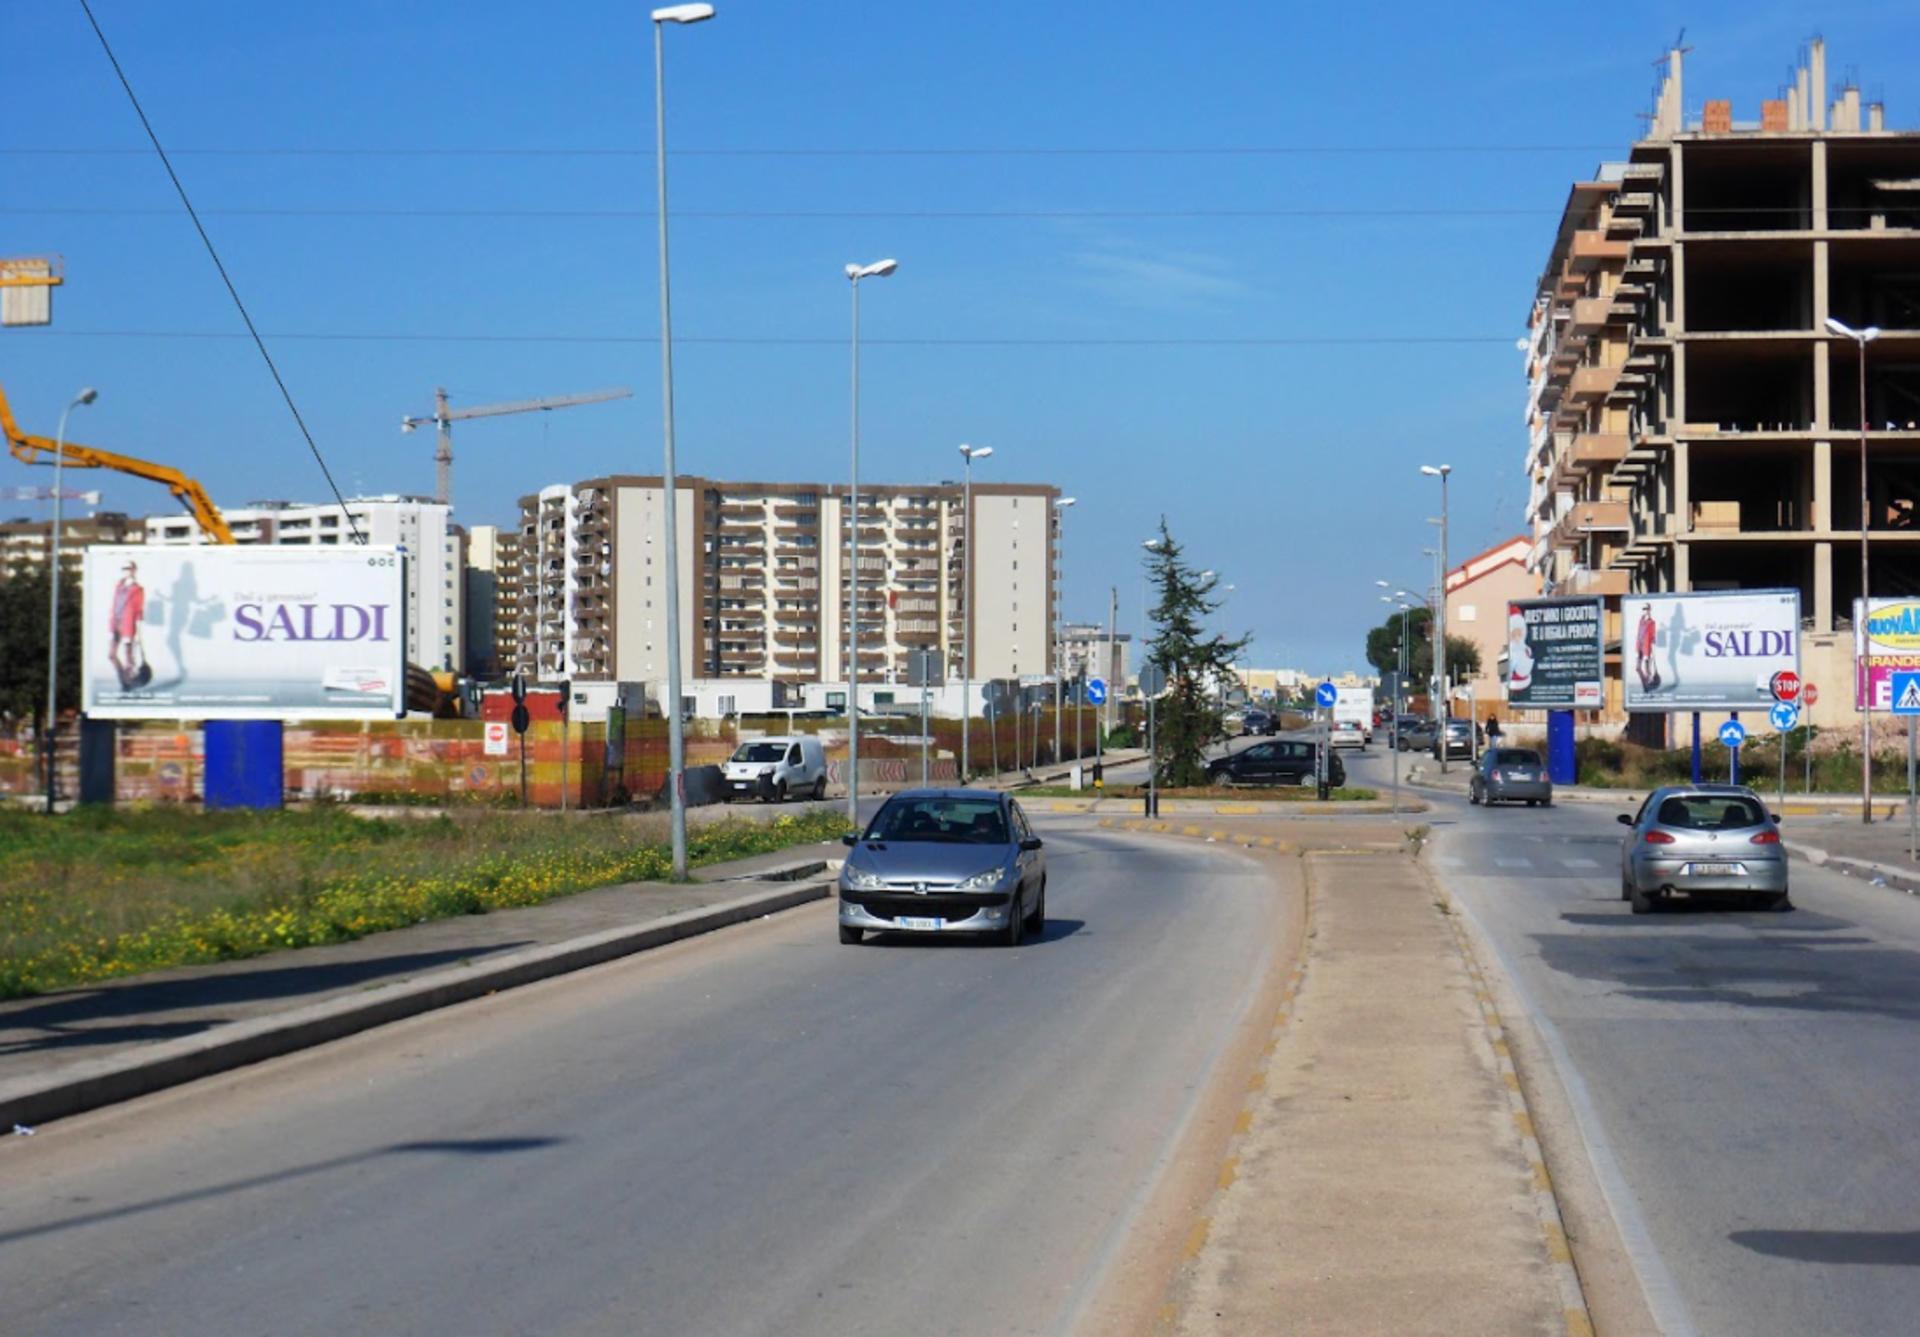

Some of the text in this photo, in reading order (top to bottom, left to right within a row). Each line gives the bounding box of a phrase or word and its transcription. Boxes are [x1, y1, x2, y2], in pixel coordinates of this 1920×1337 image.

[234, 603, 390, 642] SALDI
[1704, 630, 1794, 658] SALDI
[1775, 679, 1800, 692] STOP
